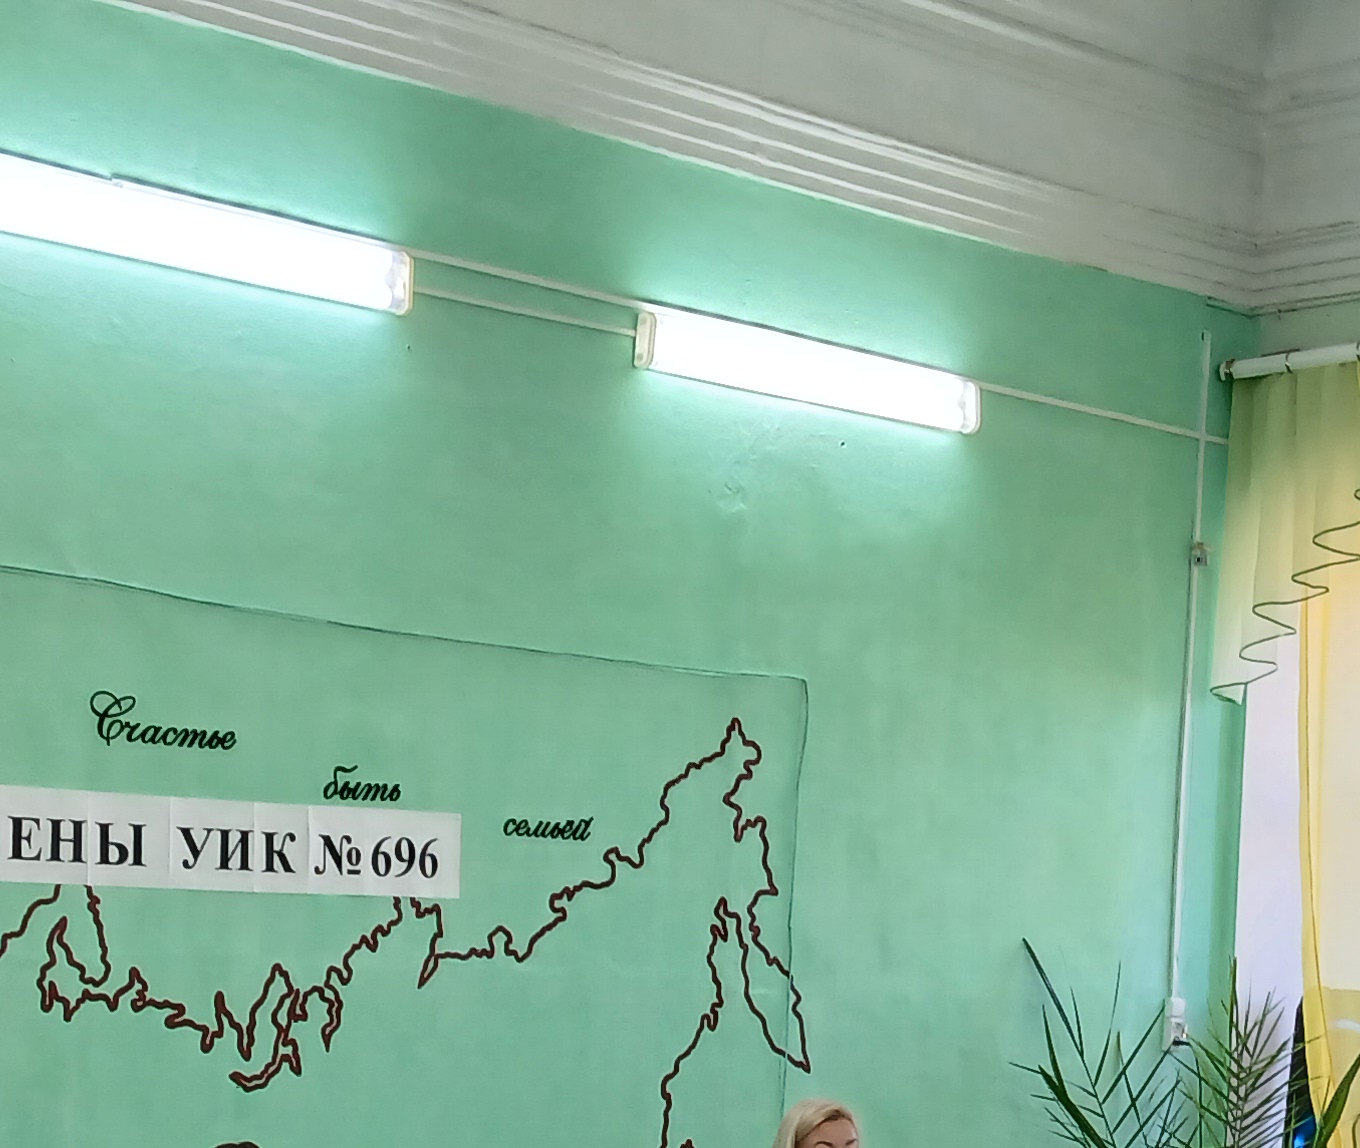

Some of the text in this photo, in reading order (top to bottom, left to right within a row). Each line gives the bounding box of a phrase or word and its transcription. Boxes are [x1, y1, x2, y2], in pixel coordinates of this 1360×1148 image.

[90, 690, 237, 750] Счастье
[322, 764, 401, 802] быть
[175, 825, 297, 874] УИК
